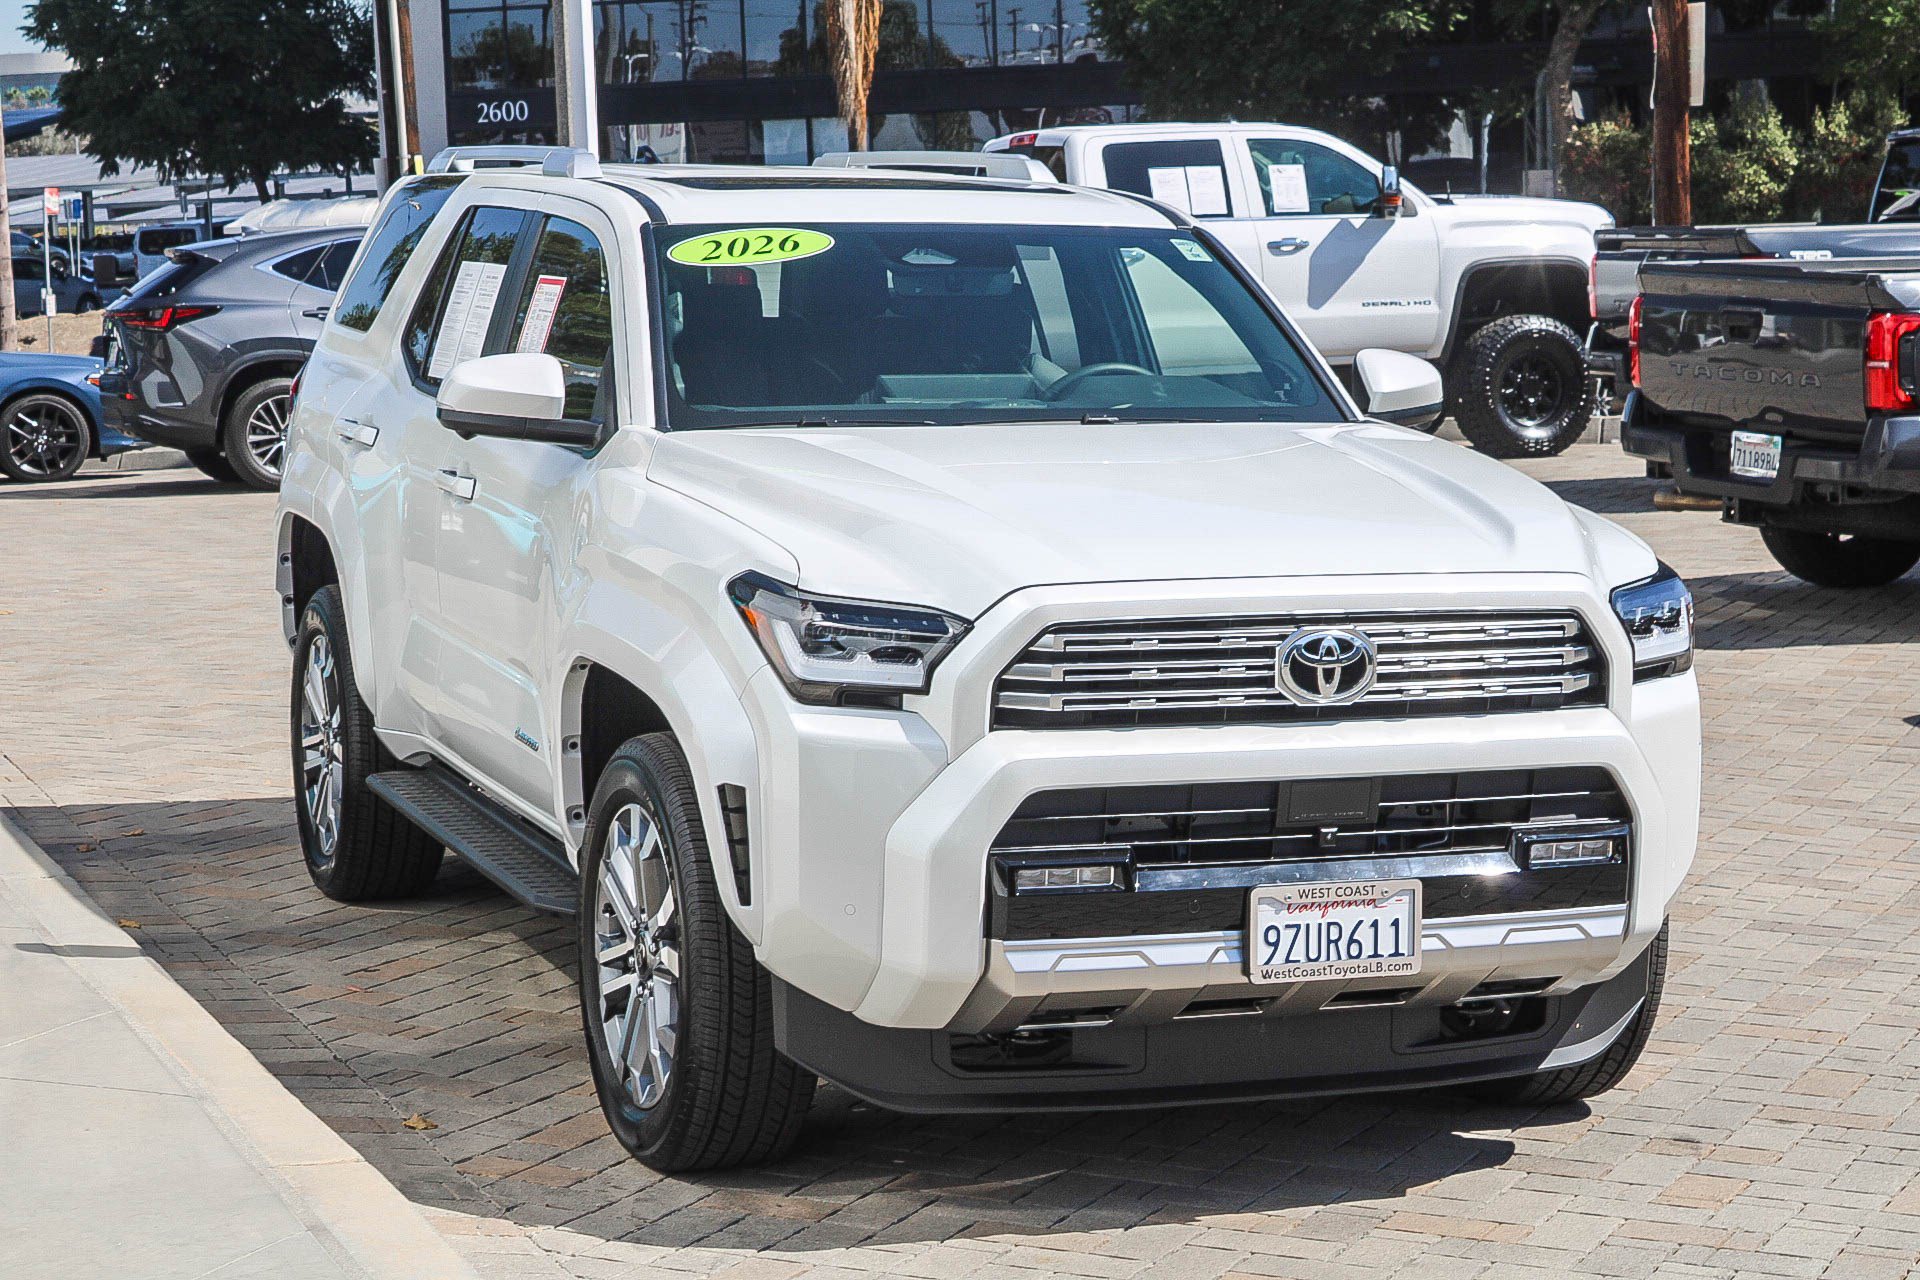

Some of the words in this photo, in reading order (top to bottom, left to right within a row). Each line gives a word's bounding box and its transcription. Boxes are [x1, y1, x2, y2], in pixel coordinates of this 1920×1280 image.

[477, 100, 529, 123] 2600
[700, 233, 801, 261] 2026
[1669, 360, 1822, 389] TACOMA
[1298, 887, 1331, 899] WEST
[1335, 885, 1376, 898] COAST
[1263, 918, 1406, 966] 9ZUR611
[1261, 961, 1413, 980] WestCoastToyotaLB.com
